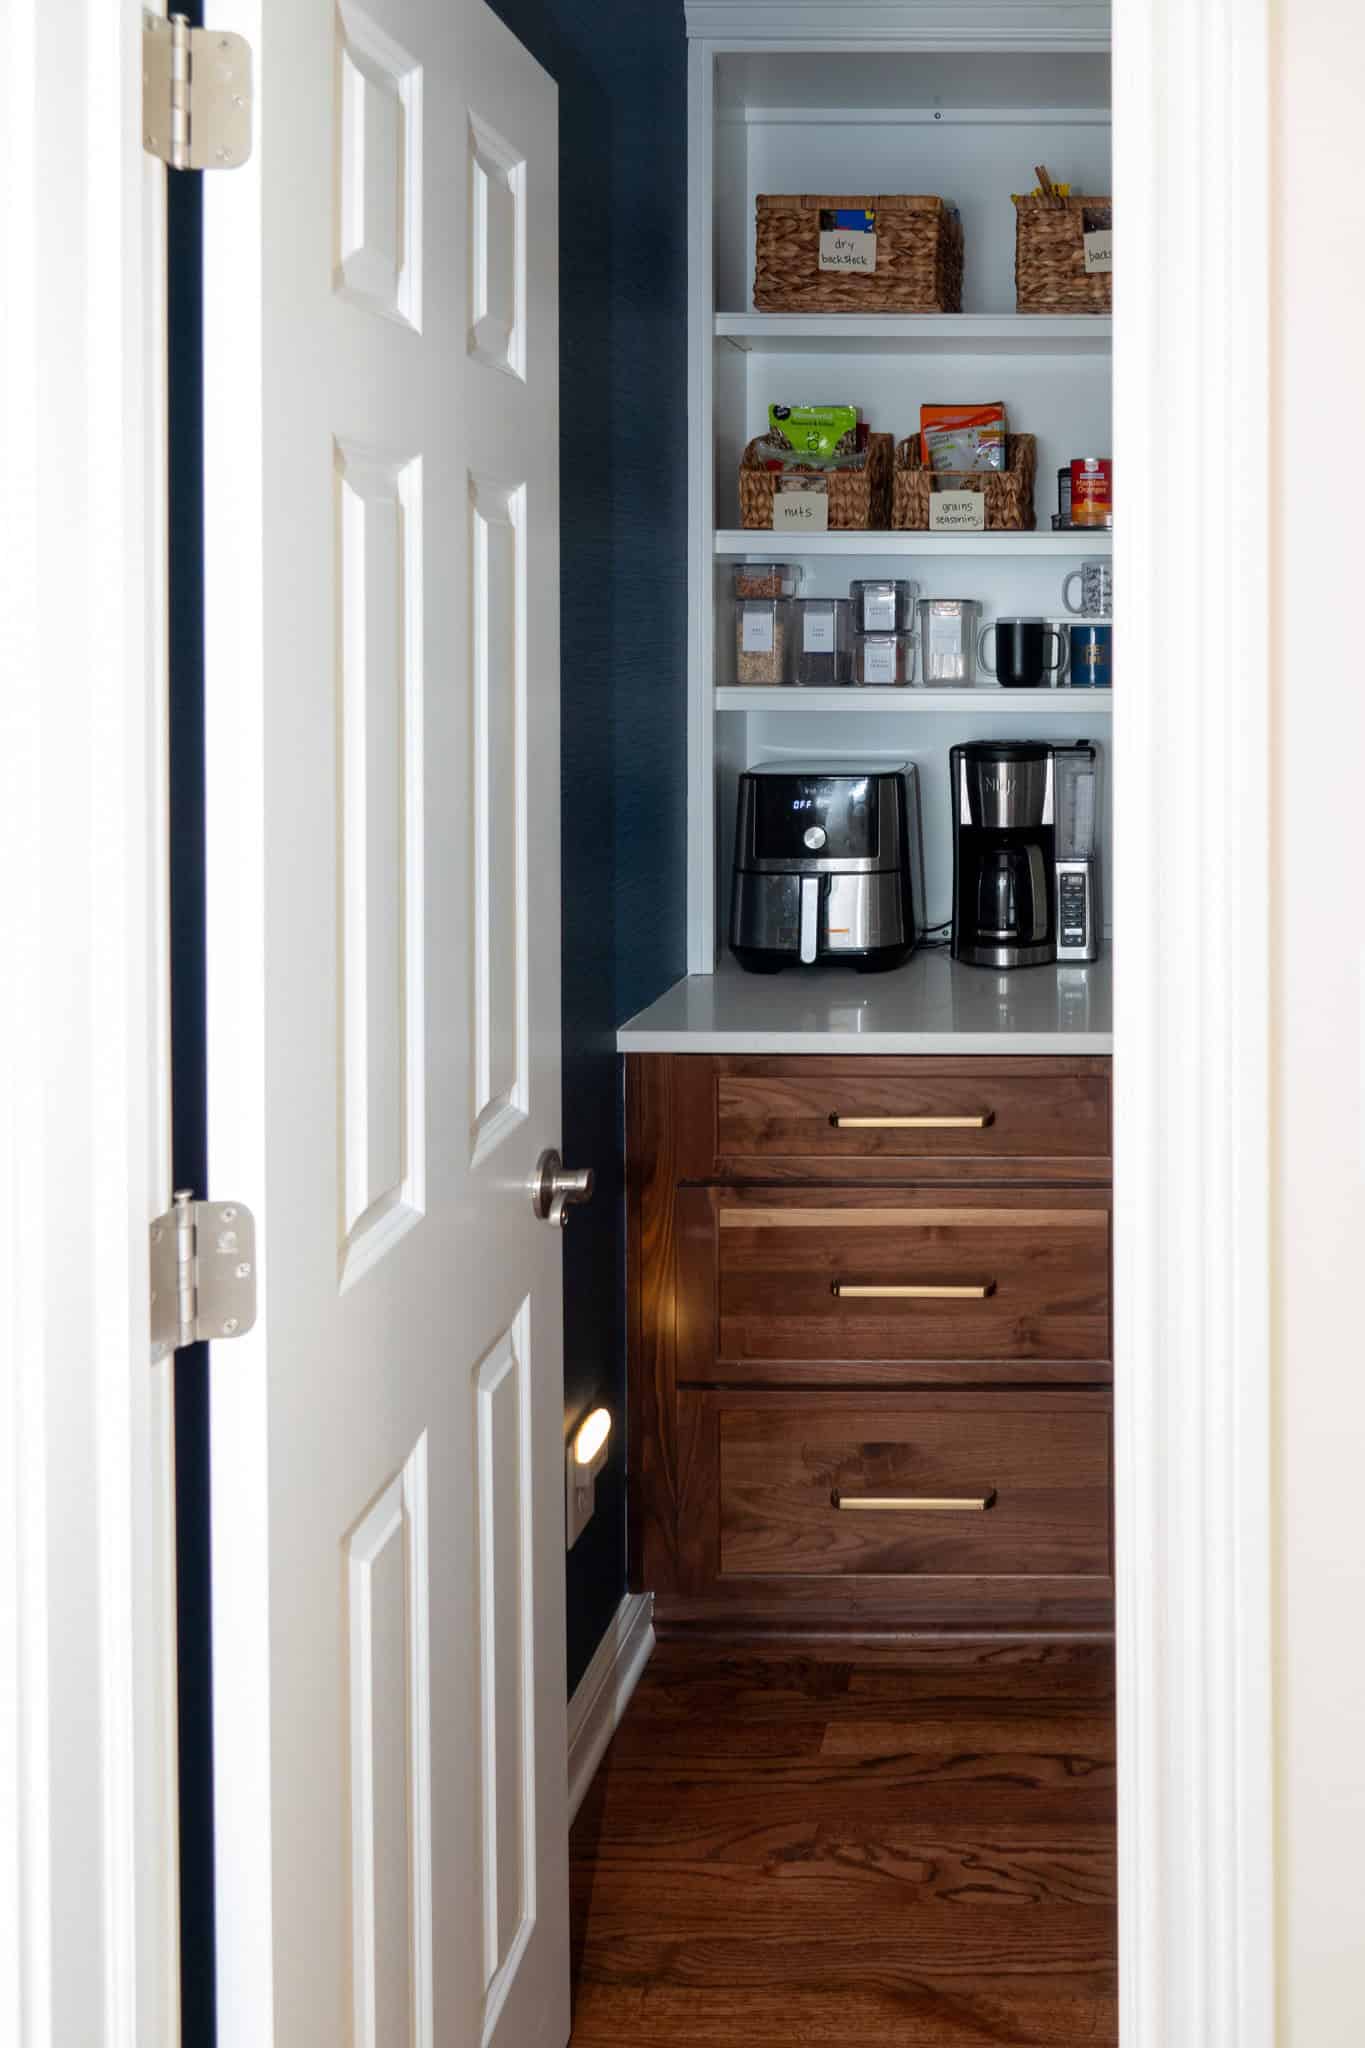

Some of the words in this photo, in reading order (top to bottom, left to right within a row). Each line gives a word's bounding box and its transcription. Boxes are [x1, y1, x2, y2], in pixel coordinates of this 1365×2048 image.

[834, 237, 855, 252] dry
[821, 254, 867, 265] backstock
[784, 504, 813, 518] nuts
[942, 502, 973, 514] grains
[792, 800, 812, 810] OFF
